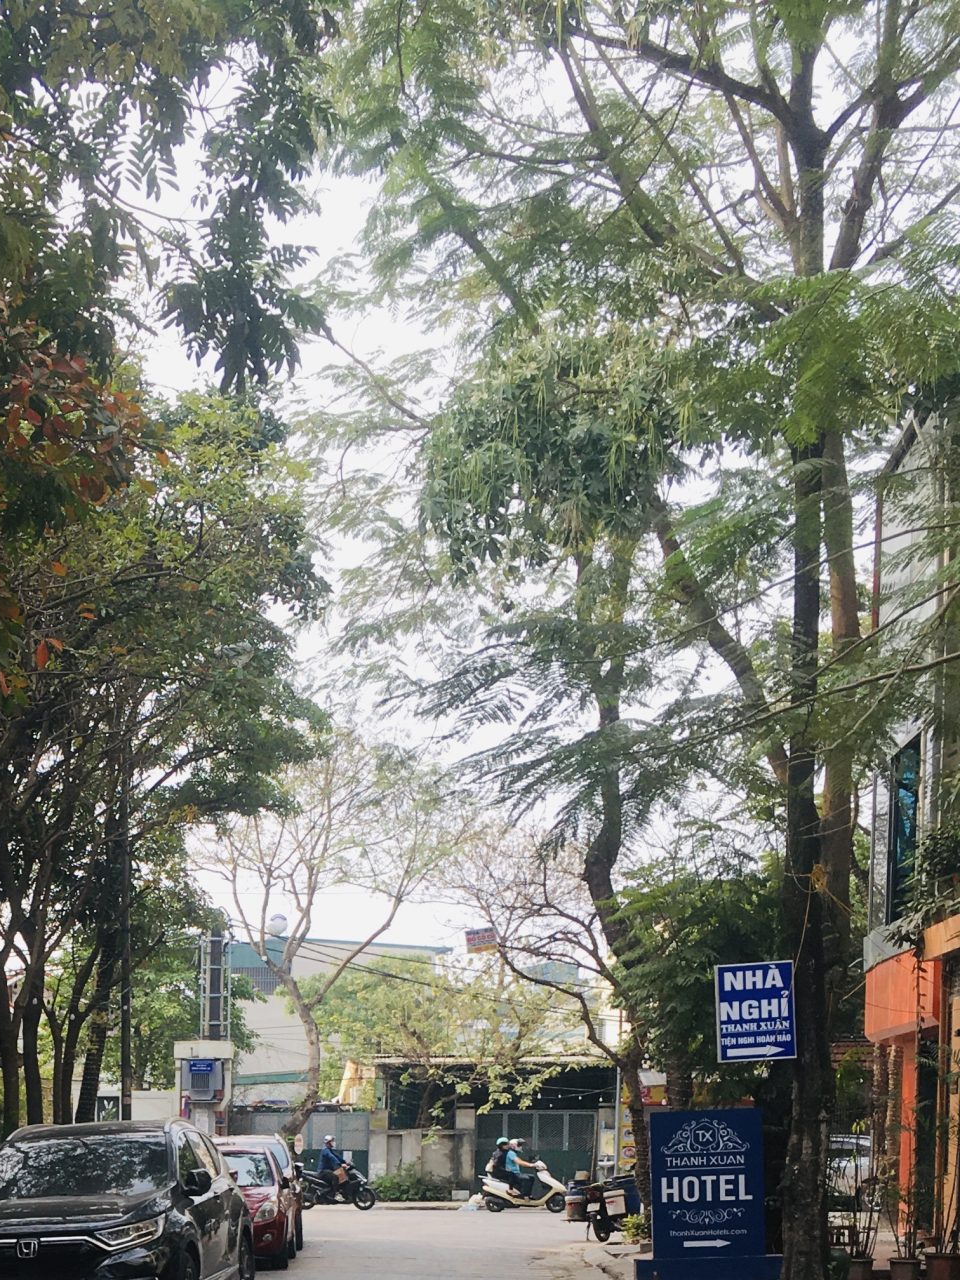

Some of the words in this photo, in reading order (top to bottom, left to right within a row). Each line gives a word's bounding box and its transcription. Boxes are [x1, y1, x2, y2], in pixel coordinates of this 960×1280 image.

[723, 964, 784, 991] NHÀ
[720, 990, 789, 1021] NGHỈ
[720, 1022, 757, 1033] THANH
[759, 1019, 790, 1030] XUÂN
[721, 1036, 736, 1047] TIỆN
[695, 1130, 713, 1142] TX
[665, 1156, 707, 1167] THANH
[709, 1154, 745, 1165] XUAN
[661, 1174, 753, 1203] HOTEL
